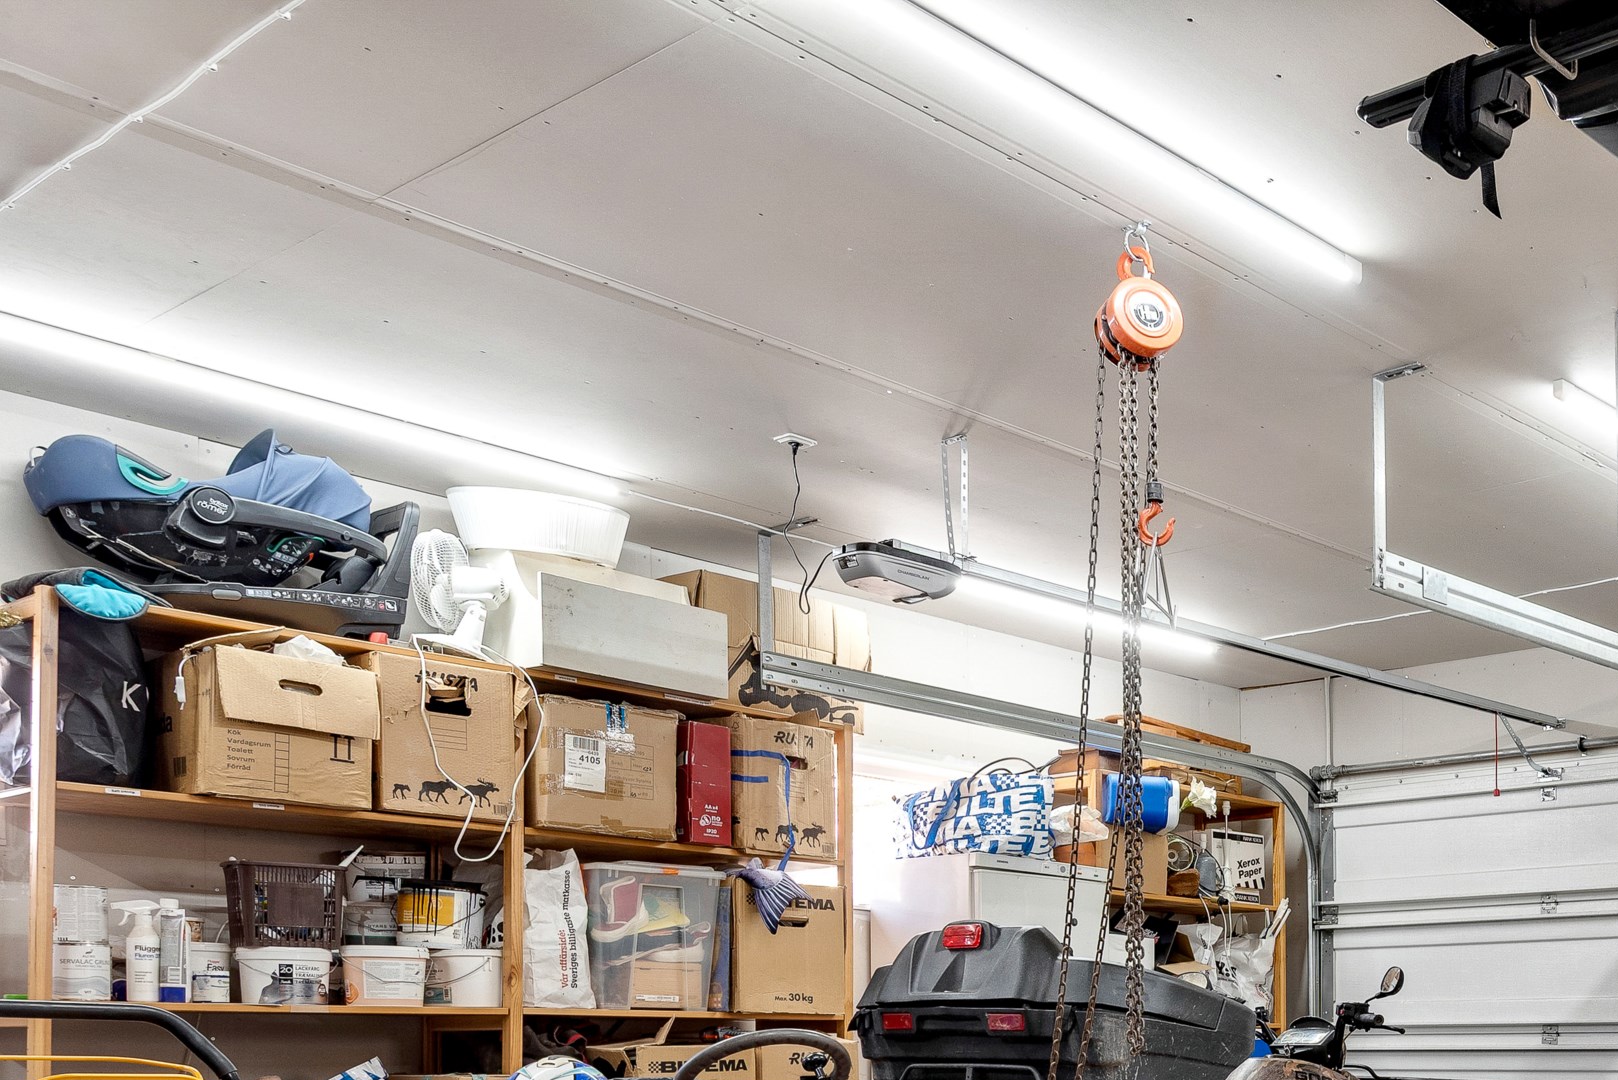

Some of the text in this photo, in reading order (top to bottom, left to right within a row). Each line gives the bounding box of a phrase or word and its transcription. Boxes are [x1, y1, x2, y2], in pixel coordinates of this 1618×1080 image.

[226, 737, 272, 748] Vardagsrum
[773, 730, 814, 749] RUA
[226, 745, 254, 755] Toalett
[226, 754, 256, 763] Sovrum
[579, 754, 601, 765] 4105
[226, 763, 251, 771] Förråd
[1237, 857, 1261, 870] Xerox
[1238, 867, 1262, 879] Paper
[562, 869, 579, 989] Sveriges billigaste matkasse
[206, 963, 225, 971] Easy
[279, 966, 293, 974] 20
[788, 993, 801, 1002] 30
[801, 993, 814, 1004] kg
[661, 1059, 748, 1073] BIEMA
